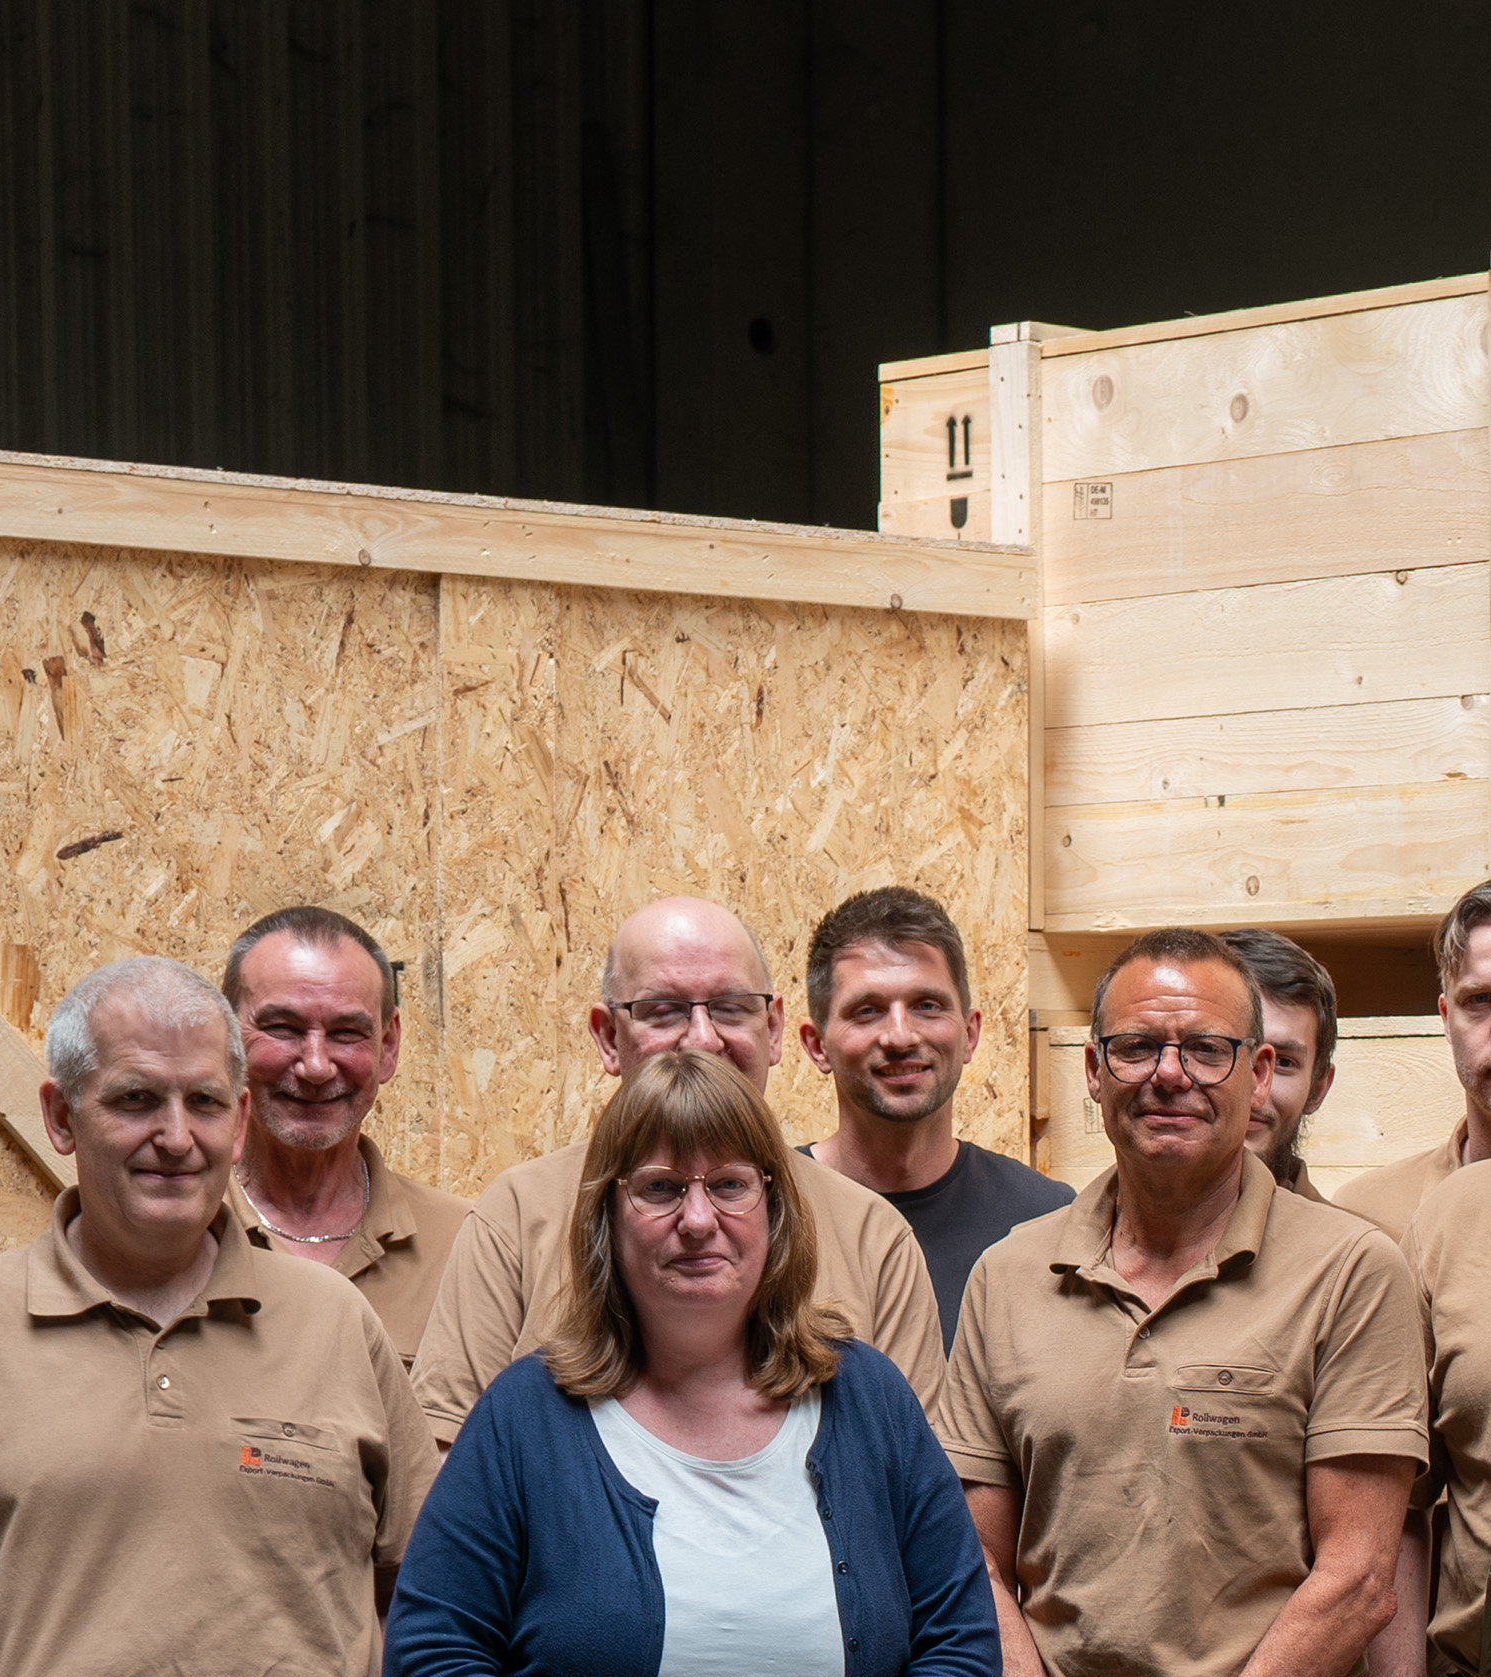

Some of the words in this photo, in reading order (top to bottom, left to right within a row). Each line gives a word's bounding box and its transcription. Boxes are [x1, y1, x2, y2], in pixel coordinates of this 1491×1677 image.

[1192, 1413, 1240, 1425] Rollwagen
[1169, 1425, 1246, 1438] Export-Verpackungen
[1247, 1430, 1268, 1438] GmbH
[264, 1453, 310, 1469] Rollwagen
[316, 1476, 335, 1488] GmbH
